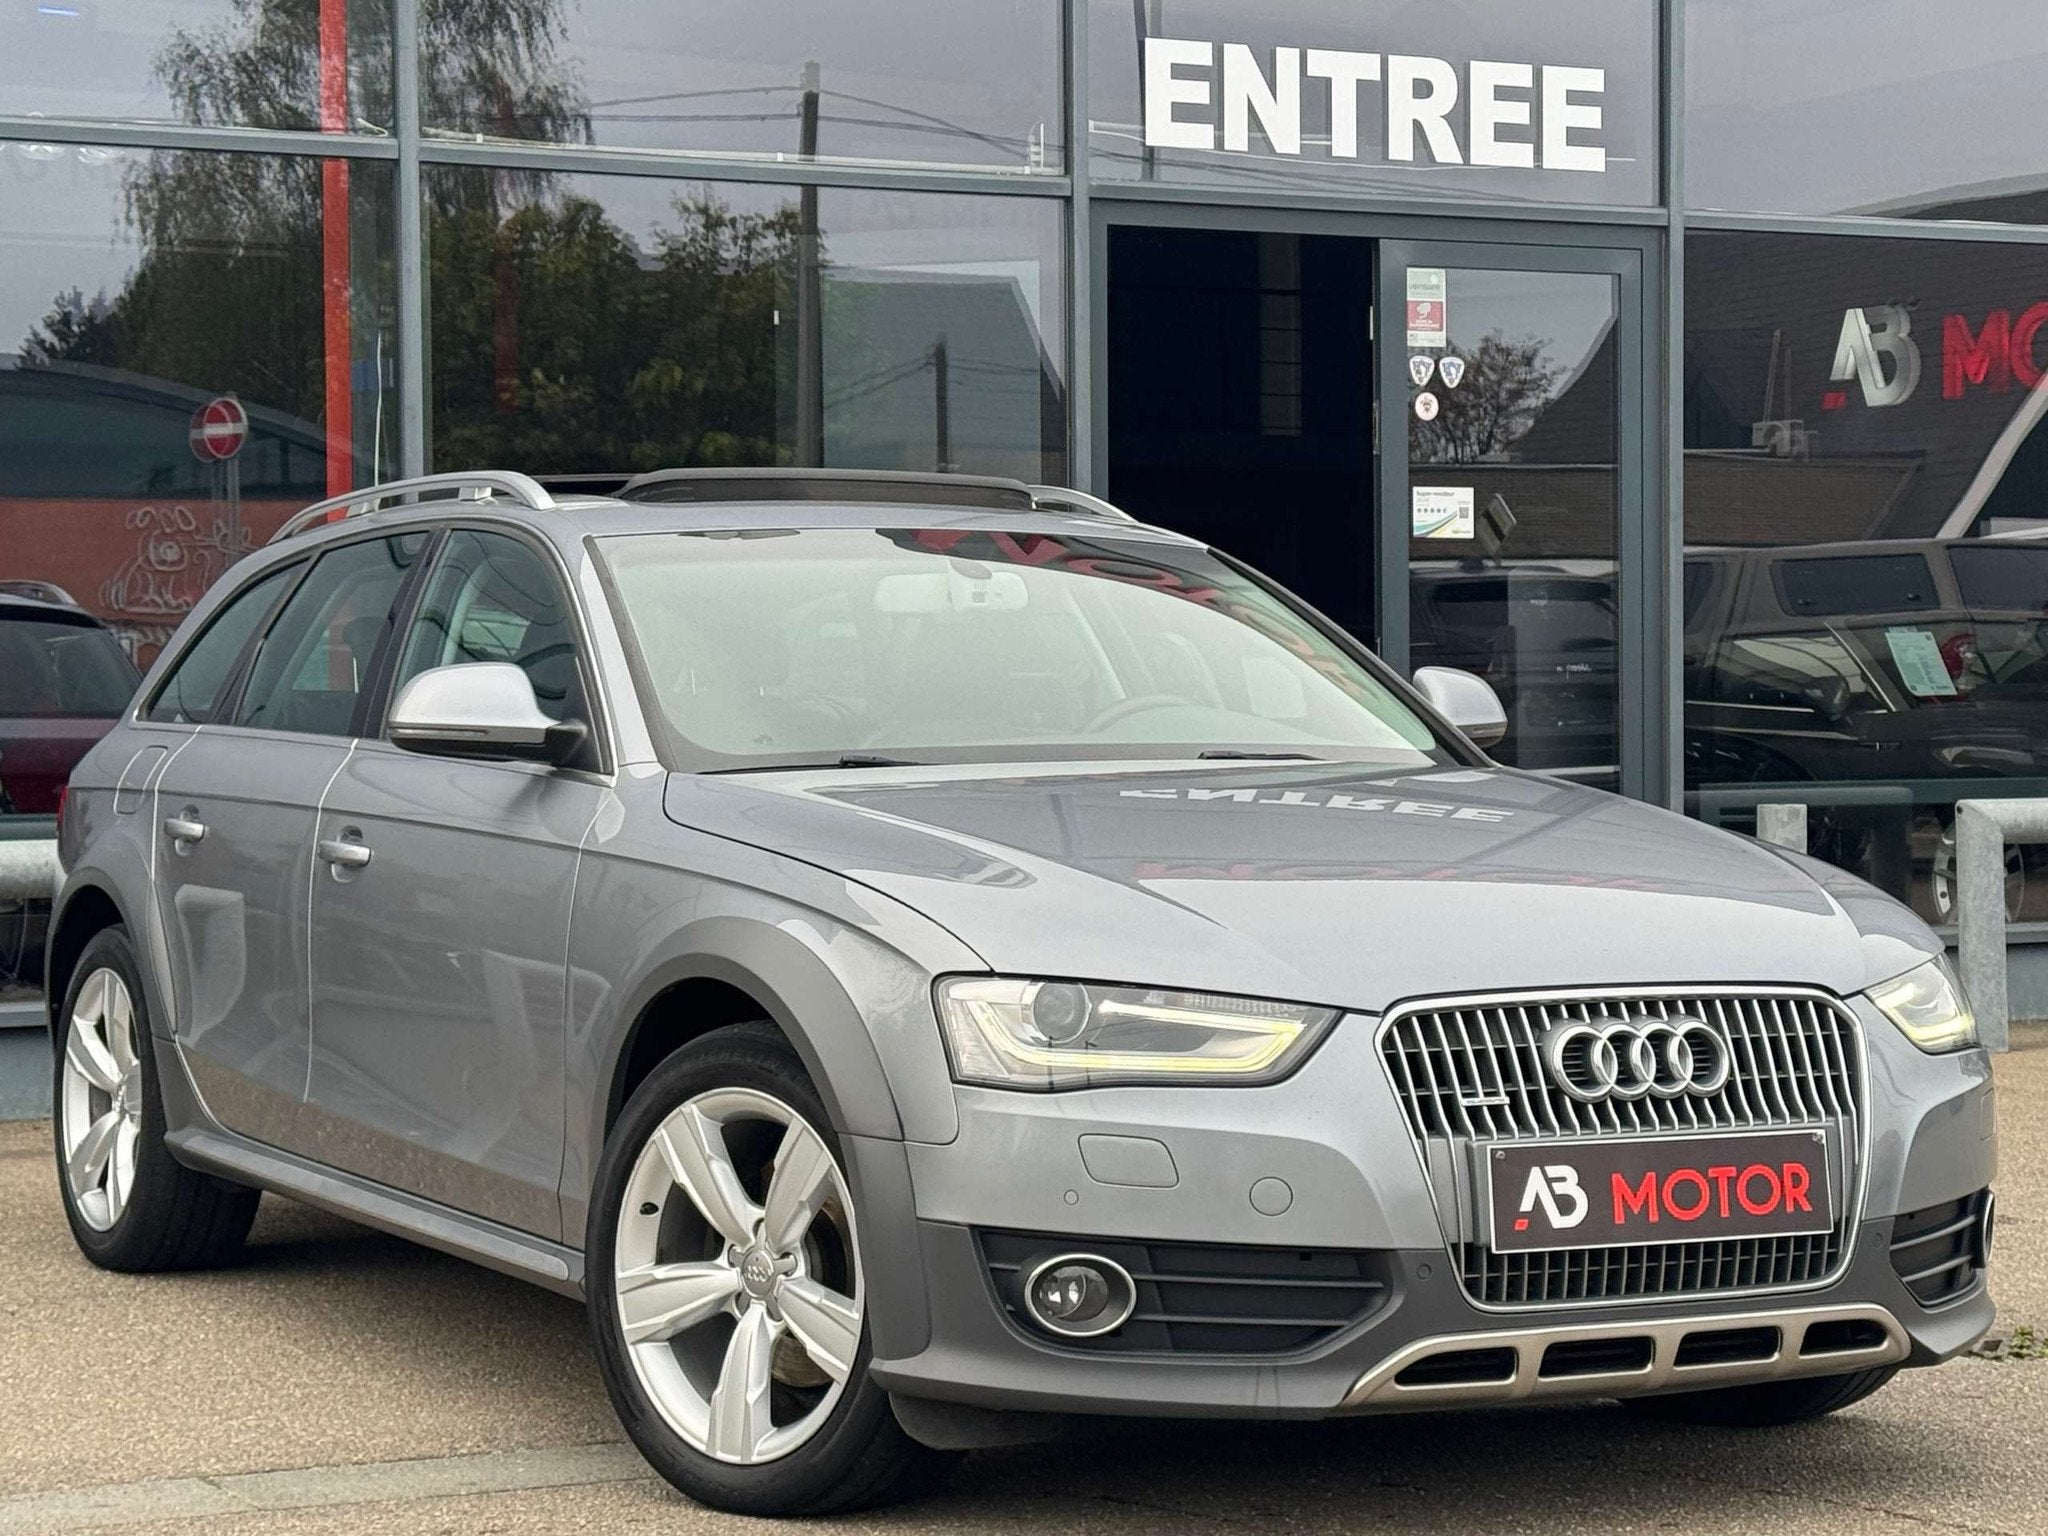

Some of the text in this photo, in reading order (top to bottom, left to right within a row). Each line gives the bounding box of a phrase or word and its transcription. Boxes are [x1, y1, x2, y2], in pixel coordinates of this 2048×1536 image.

[1144, 37, 1606, 173] ENTREE
[1518, 1162, 1813, 1229] AB MOTOR
